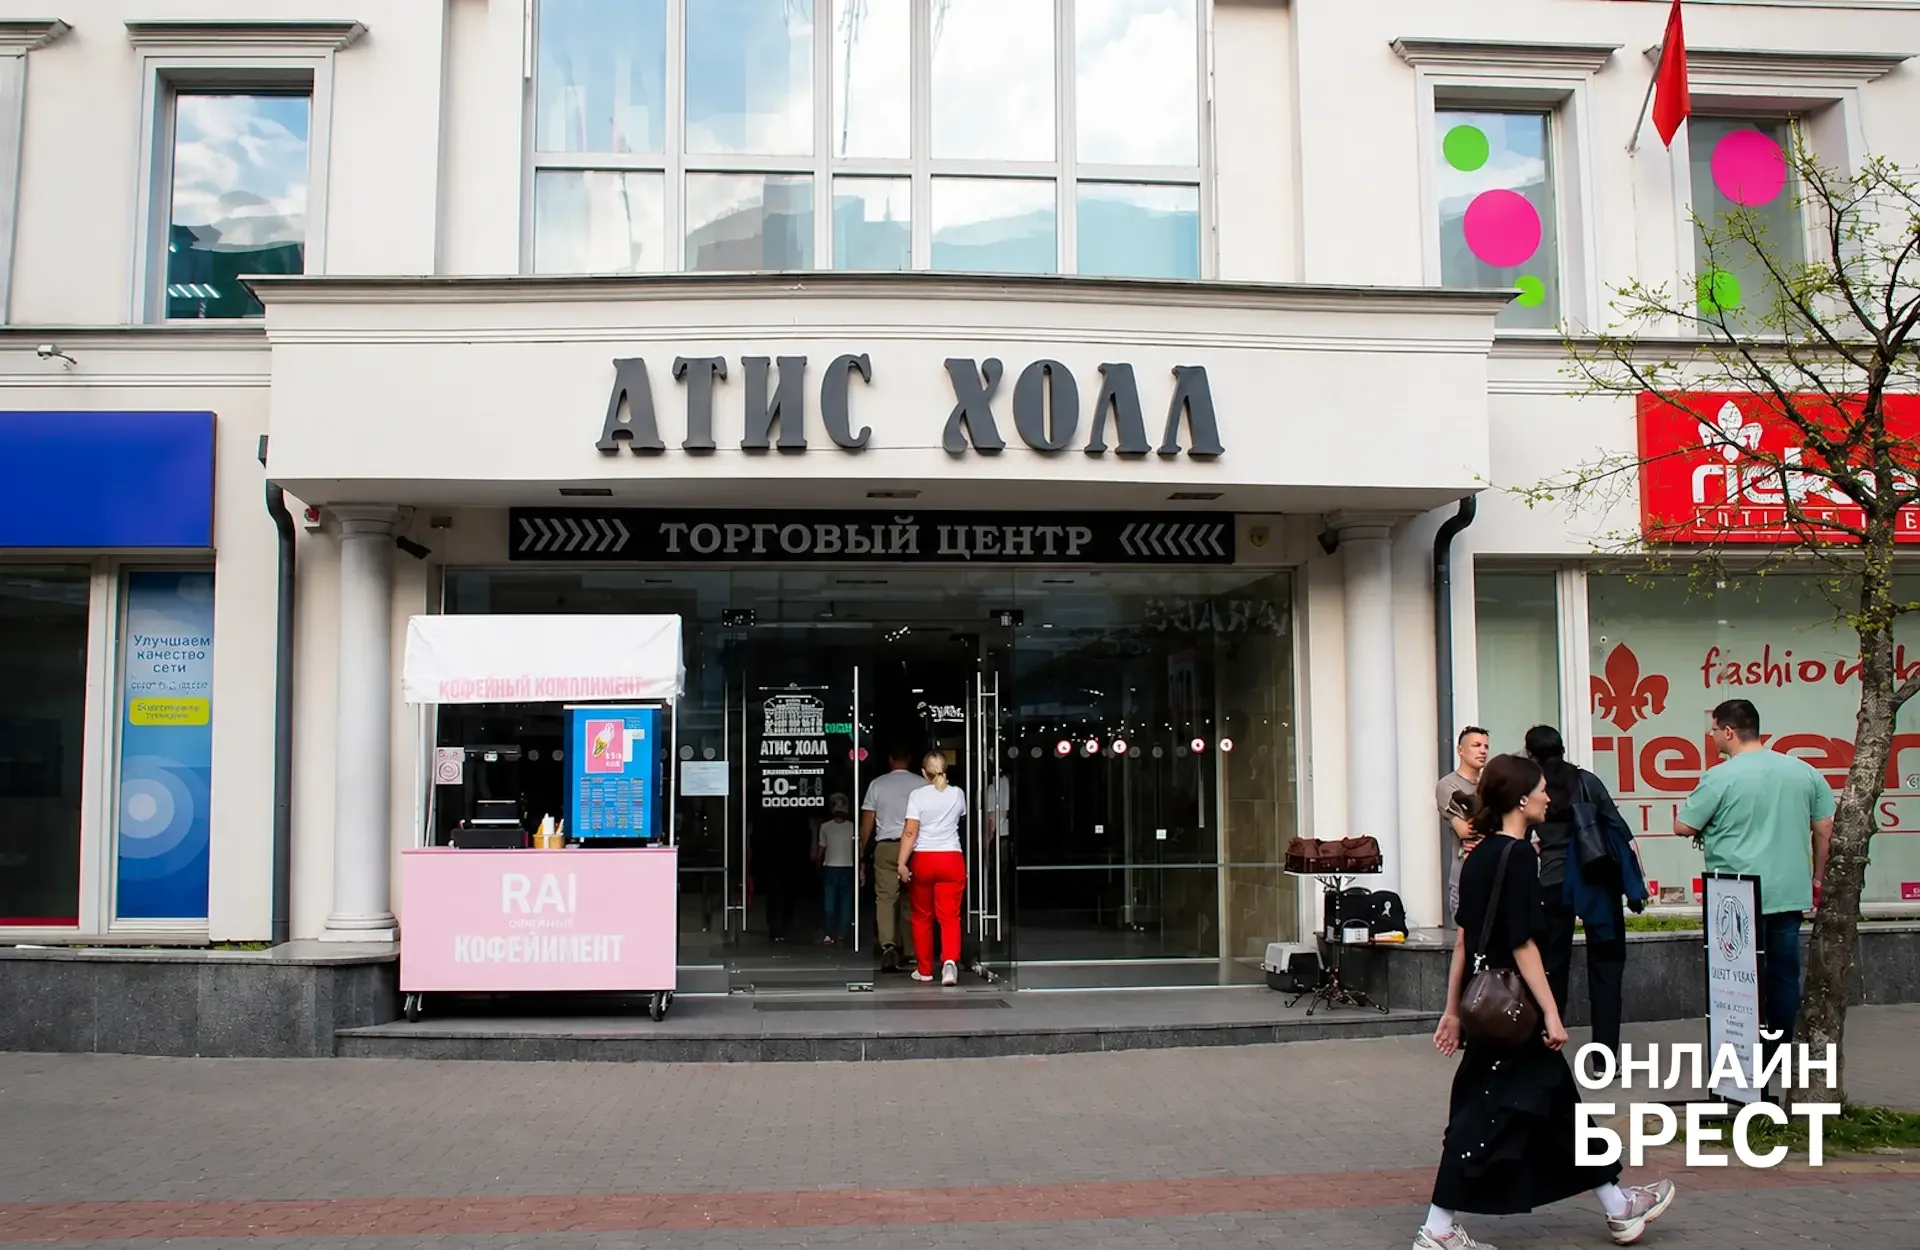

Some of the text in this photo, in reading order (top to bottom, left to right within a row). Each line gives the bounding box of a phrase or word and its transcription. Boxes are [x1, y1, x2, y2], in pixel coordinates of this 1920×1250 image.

[595, 353, 1225, 456] АТИС ХОЛЛ
[658, 515, 1093, 560] ТОРГОВЫЙ ЦЕНТР
[133, 634, 211, 648] Улучшаем
[136, 650, 205, 660] качество
[152, 664, 187, 673] сети
[1701, 644, 1864, 688] fashion
[438, 675, 531, 700] КОФЕЙНЫЙ
[501, 872, 578, 914] RAI
